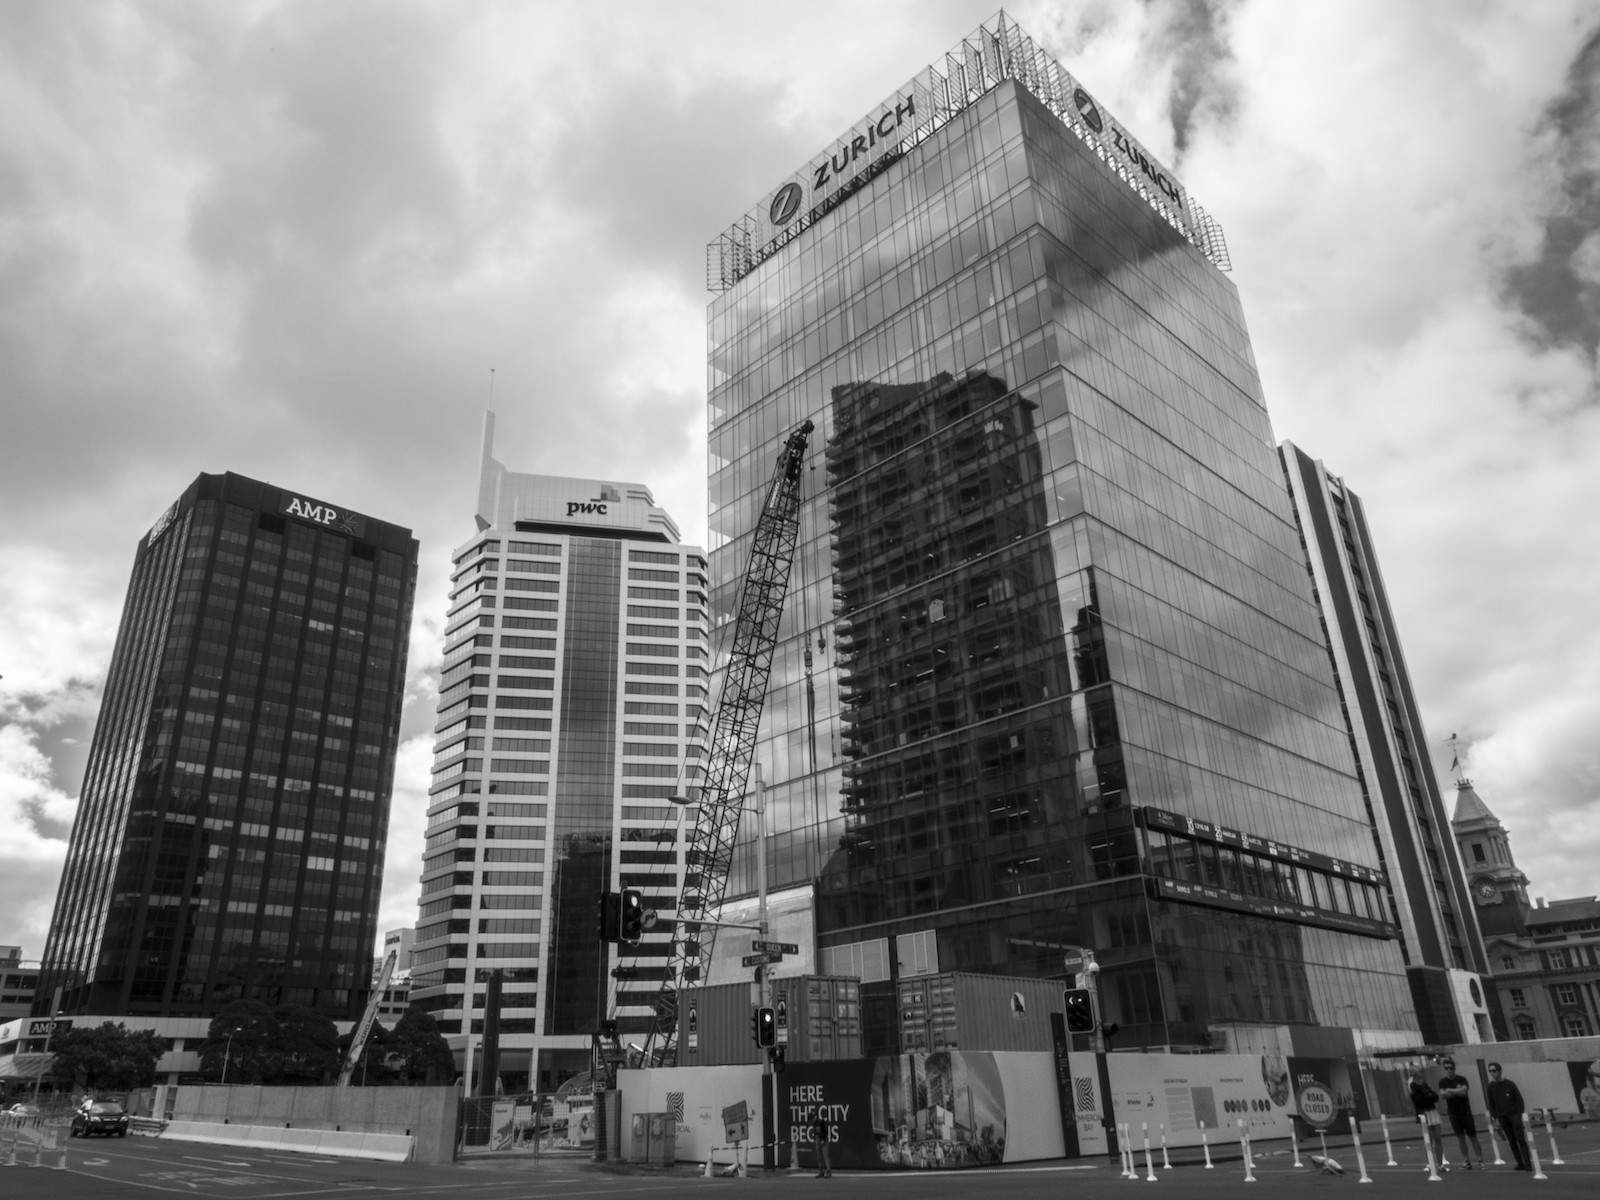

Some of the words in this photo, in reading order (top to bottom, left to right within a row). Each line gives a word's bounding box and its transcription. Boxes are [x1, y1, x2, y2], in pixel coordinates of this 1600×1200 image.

[814, 93, 916, 191] ZURICH
[1111, 126, 1183, 210] ZURICH
[286, 497, 337, 525] AMP
[566, 501, 607, 517] pwc
[766, 943, 782, 952] QUEEN
[789, 1085, 824, 1103] HERE
[1307, 1093, 1325, 1102] ROAD
[817, 1104, 850, 1122] CITY
[1304, 1104, 1330, 1114] CLOSED
